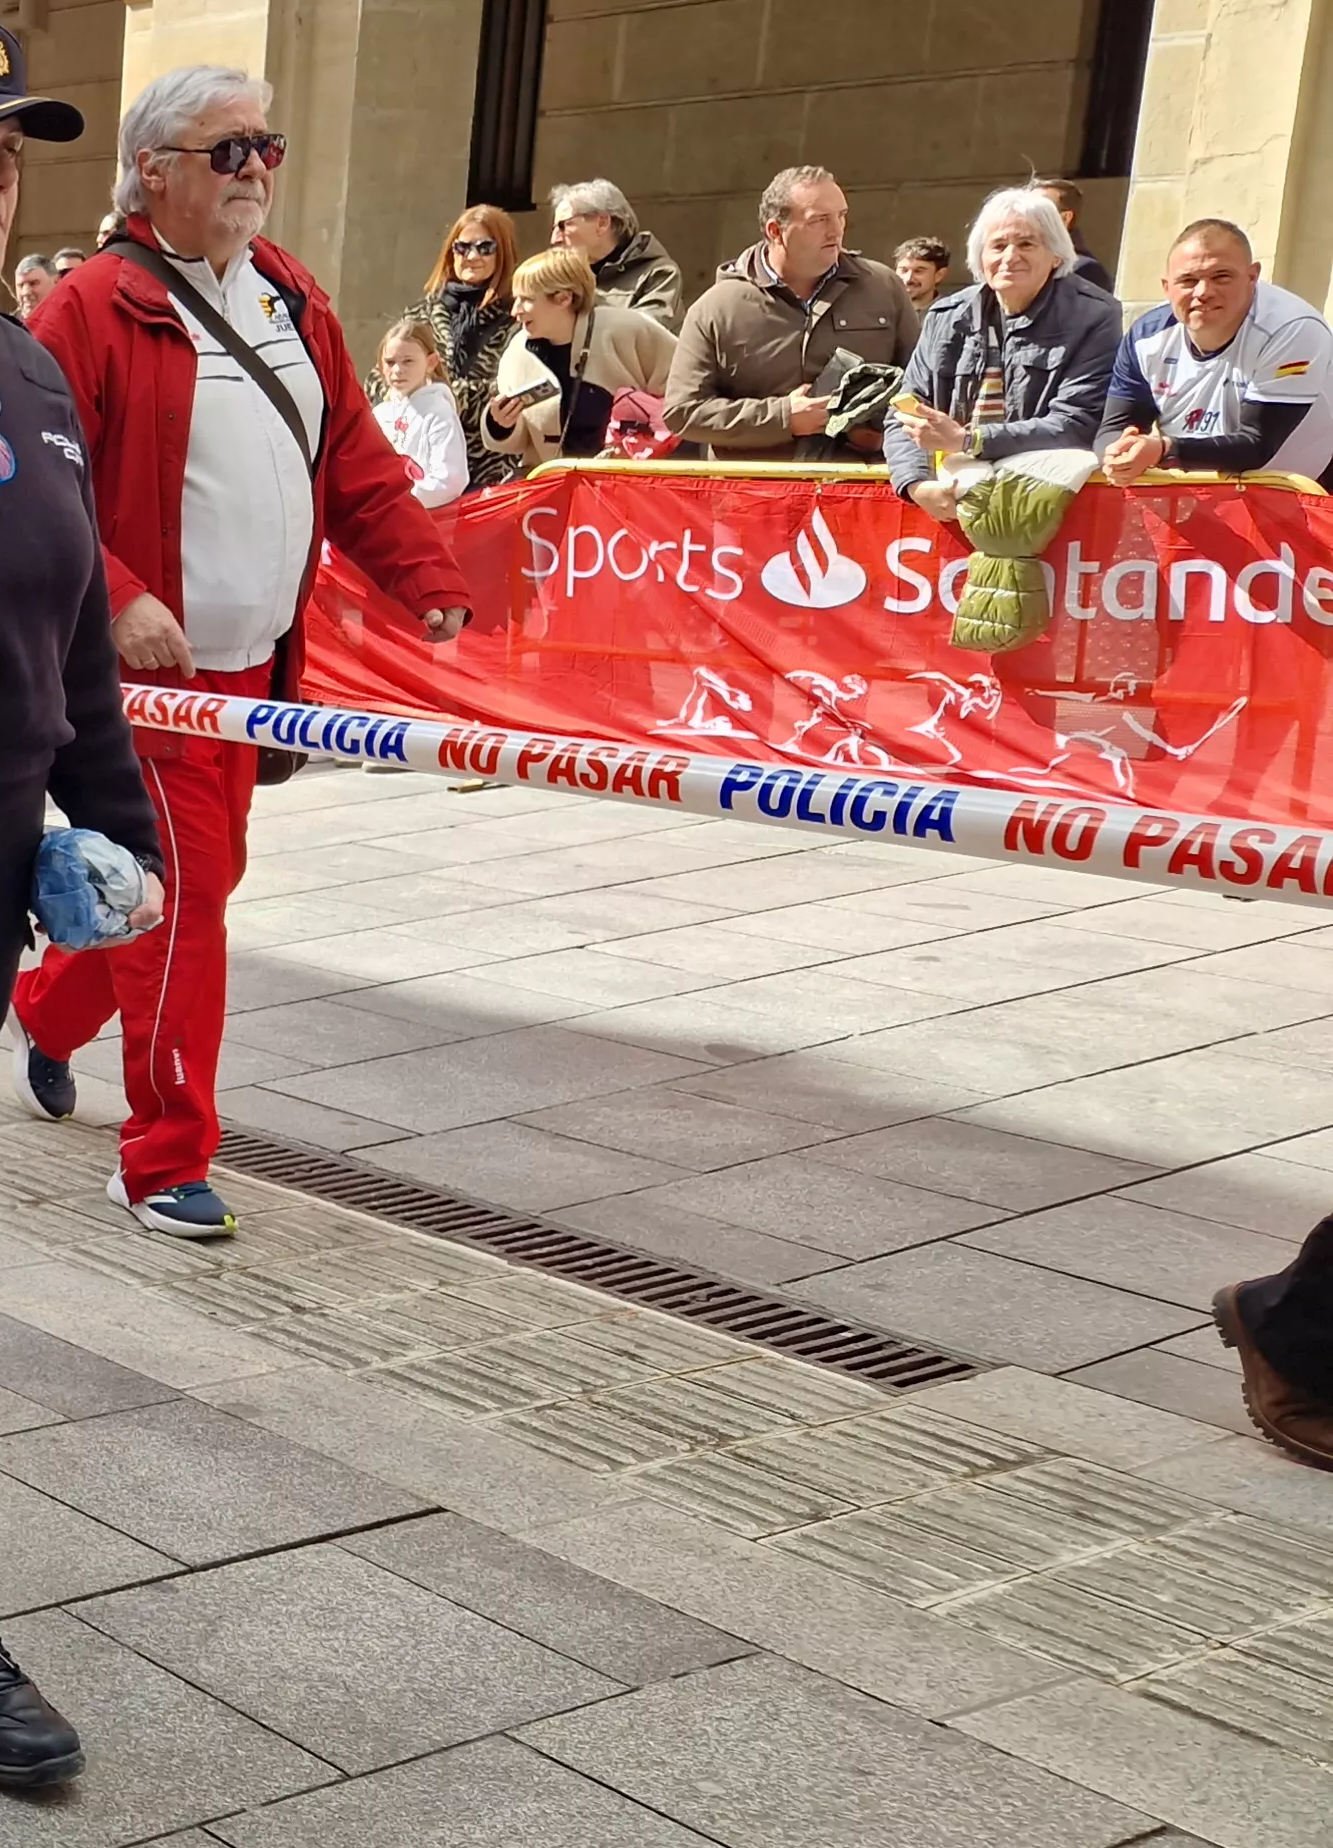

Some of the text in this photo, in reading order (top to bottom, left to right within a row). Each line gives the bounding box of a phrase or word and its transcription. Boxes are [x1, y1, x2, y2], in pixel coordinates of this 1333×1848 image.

[276, 323, 293, 332] JUE
[520, 506, 1333, 626] Sports Stande
[246, 704, 411, 763] POLICIA
[438, 727, 499, 776] NO
[516, 737, 690, 802] PASAR
[719, 763, 960, 843] POLICIA
[1004, 799, 1109, 862] NO
[1123, 814, 1333, 896] PASA
